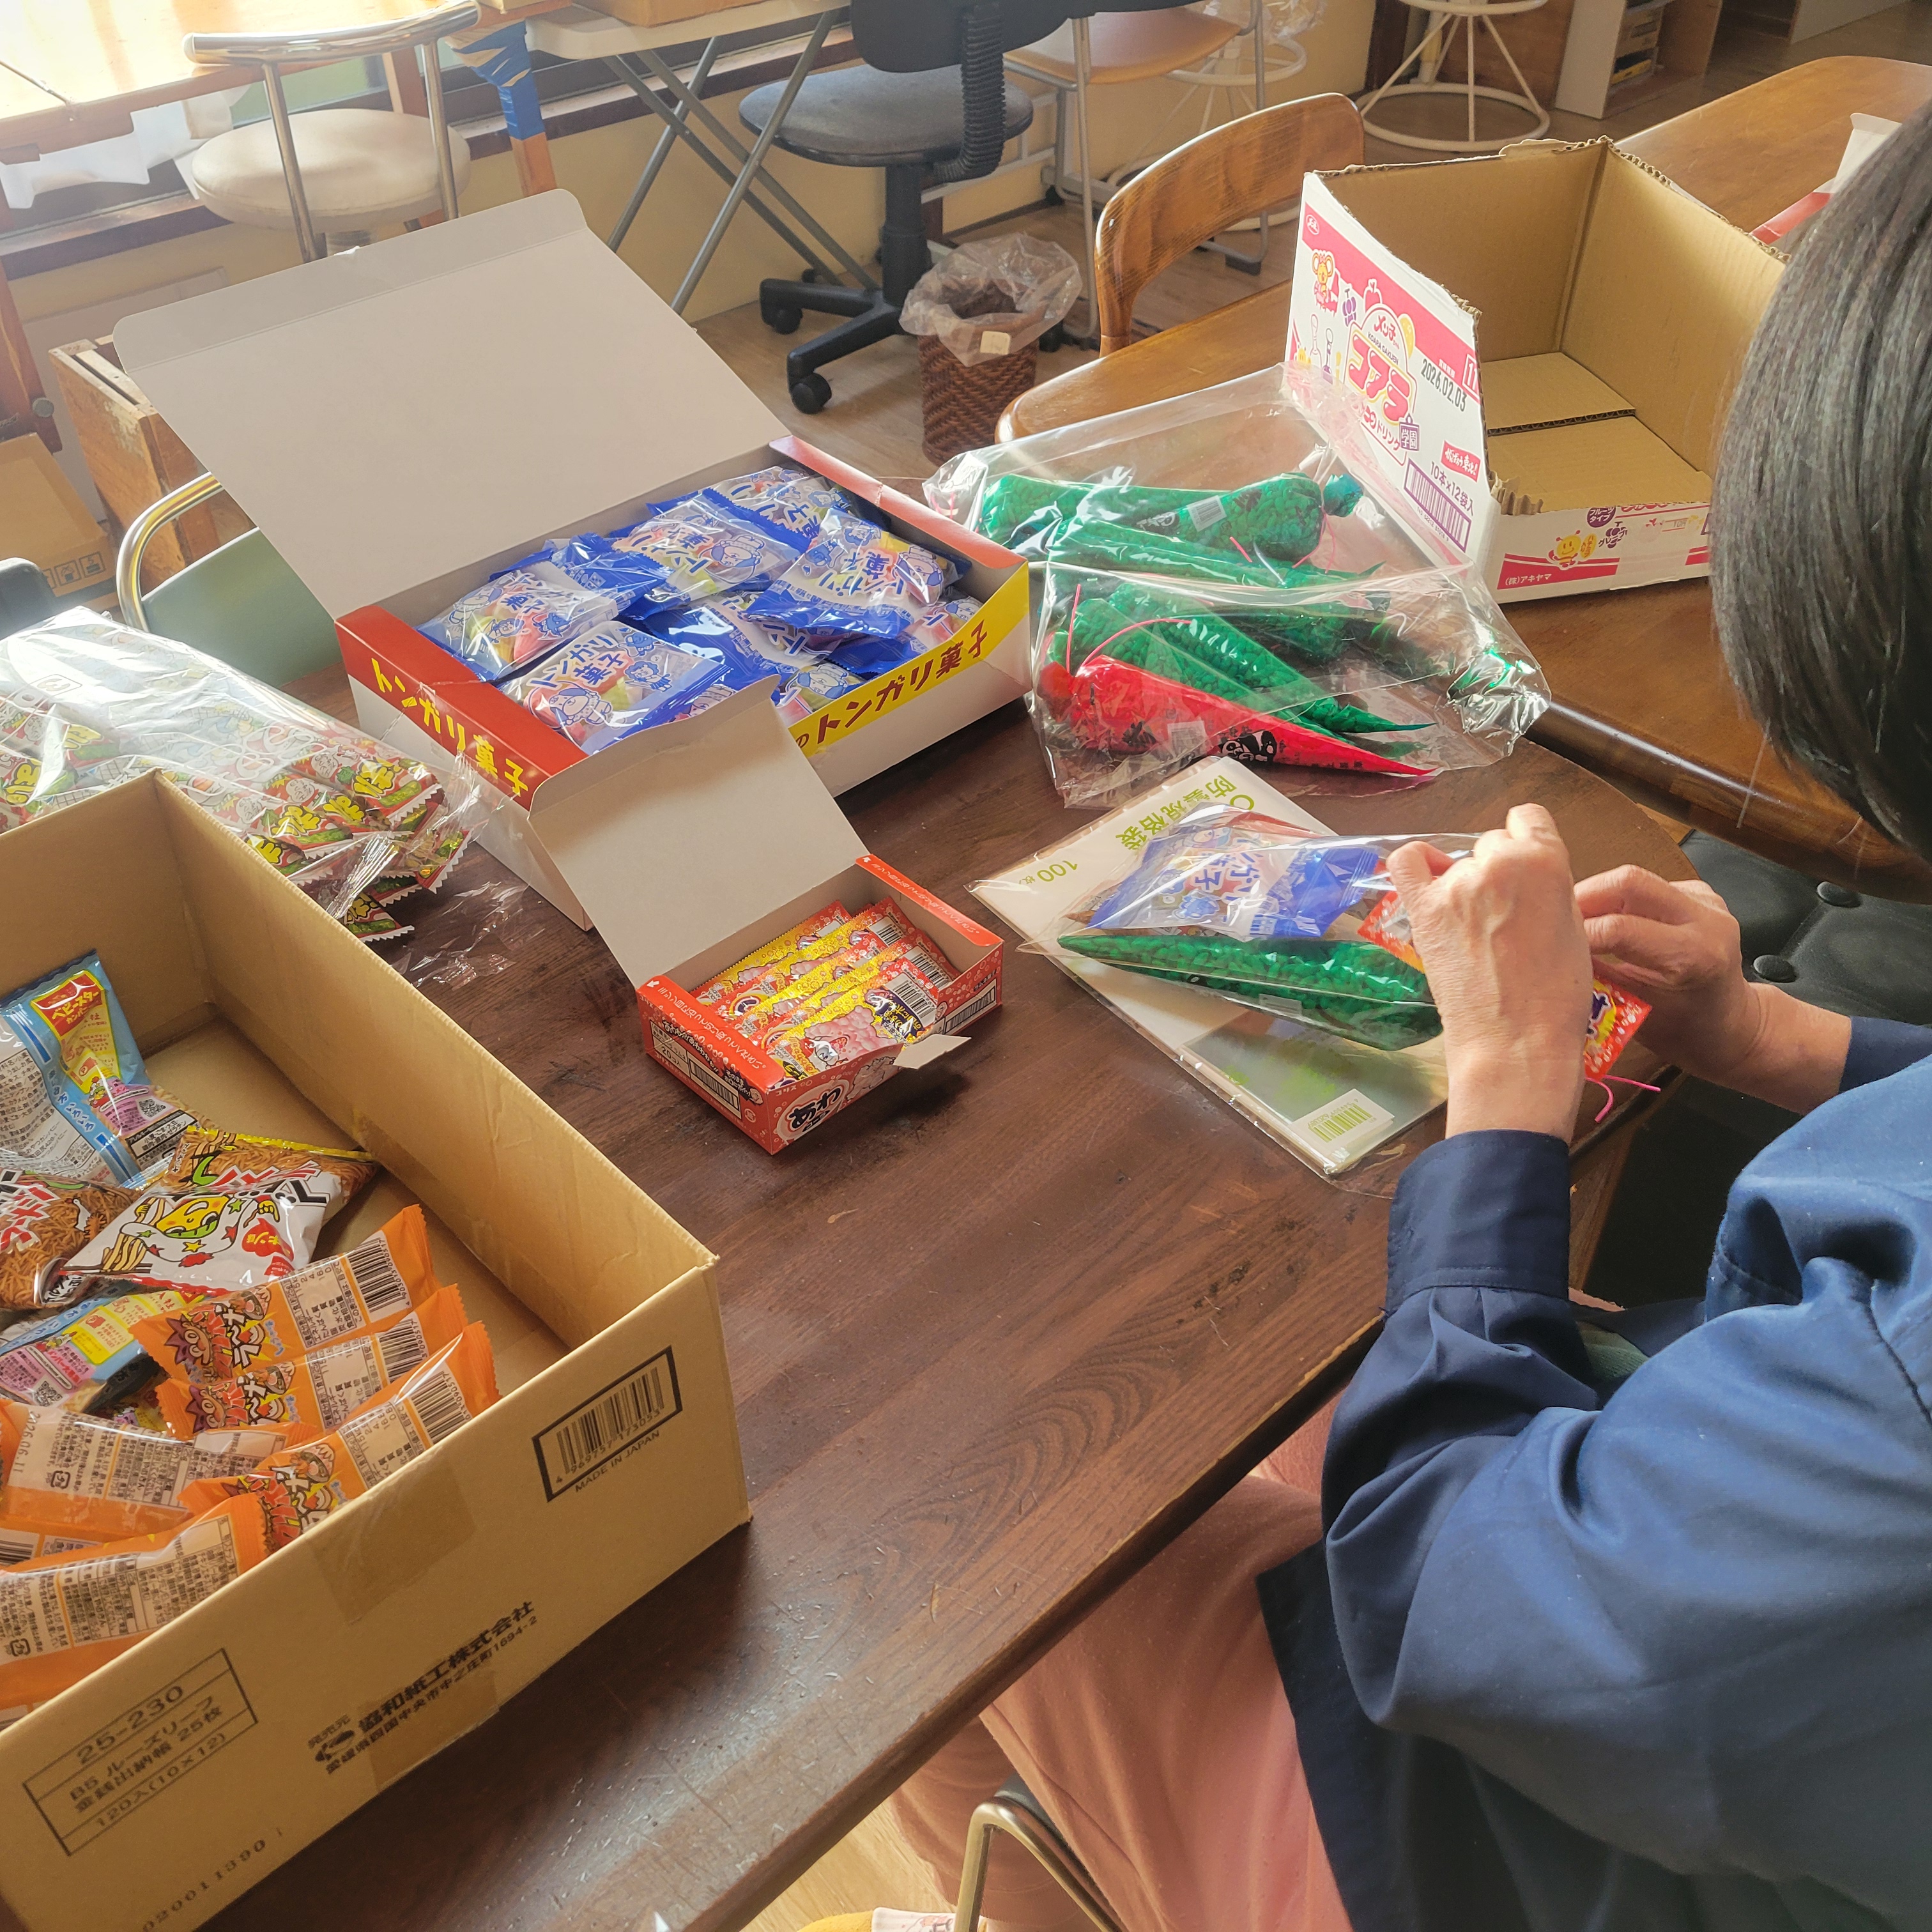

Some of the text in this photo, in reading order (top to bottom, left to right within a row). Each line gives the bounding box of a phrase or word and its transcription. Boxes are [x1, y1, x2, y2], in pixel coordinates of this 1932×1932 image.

[1421, 358, 1468, 412] 2026.02.03
[1401, 428, 1418, 450] 学園
[1589, 506, 1614, 516] フルーツ
[1590, 514, 1611, 523] タイプ
[1505, 573, 1552, 586] (株)アキヤマ
[529, 634, 616, 688] トンガリ
[575, 652, 625, 685] 菓子
[371, 658, 528, 797] トンガリ菓子
[52, 991, 100, 1020] ベビースター
[788, 1087, 841, 1130] あわ
[301, 1309, 321, 1345] エネルギー
[556, 1408, 661, 1484] 4 969757 173053
[576, 1430, 661, 1492] MADE IN JAPAN
[358, 1600, 535, 1733] 協和紙工株式会社
[77, 1685, 184, 1765] 25-230
[106, 1695, 215, 1780] ルーズリーフ
[177, 1706, 224, 1742] 25枚
